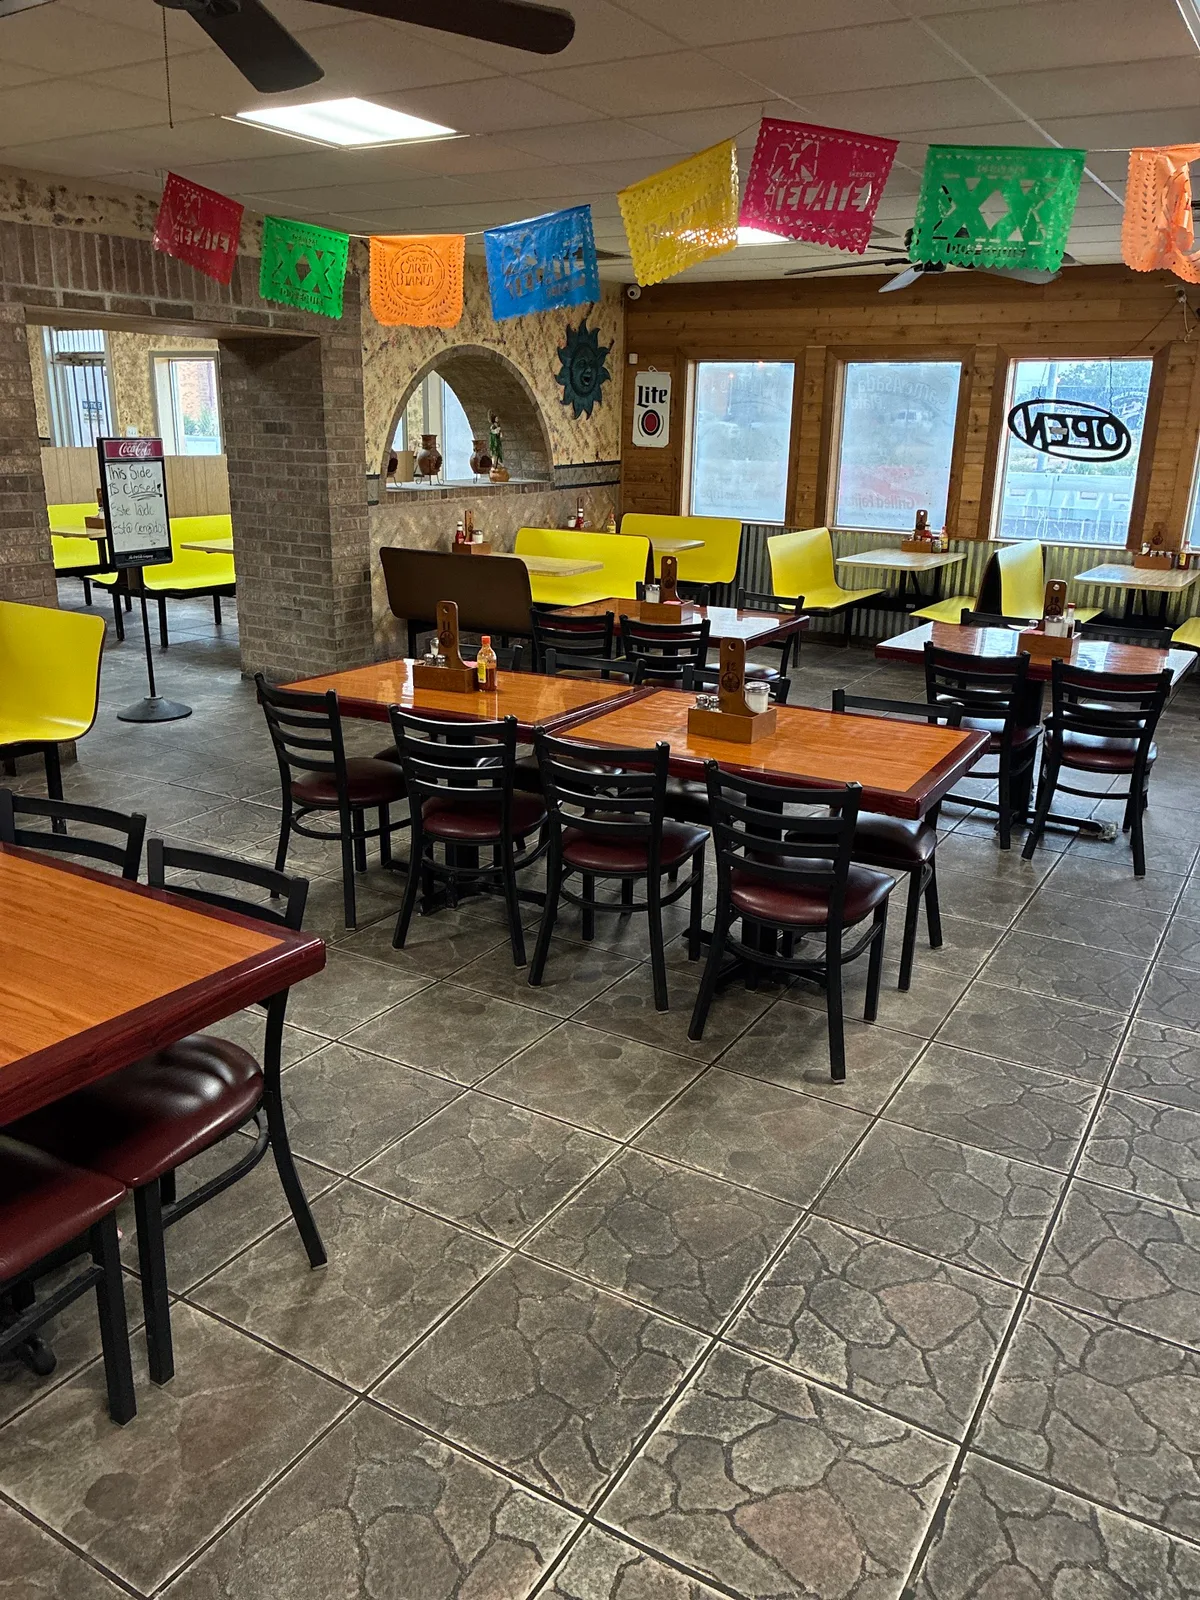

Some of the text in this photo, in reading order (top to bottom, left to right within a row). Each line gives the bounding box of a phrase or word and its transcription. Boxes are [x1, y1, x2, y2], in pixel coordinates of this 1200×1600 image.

[401, 260, 434, 274] CARTA
[396, 271, 436, 287] BLANCA
[636, 385, 668, 408] Lite
[106, 463, 153, 480] This Side
[726, 661, 738, 672] 12
